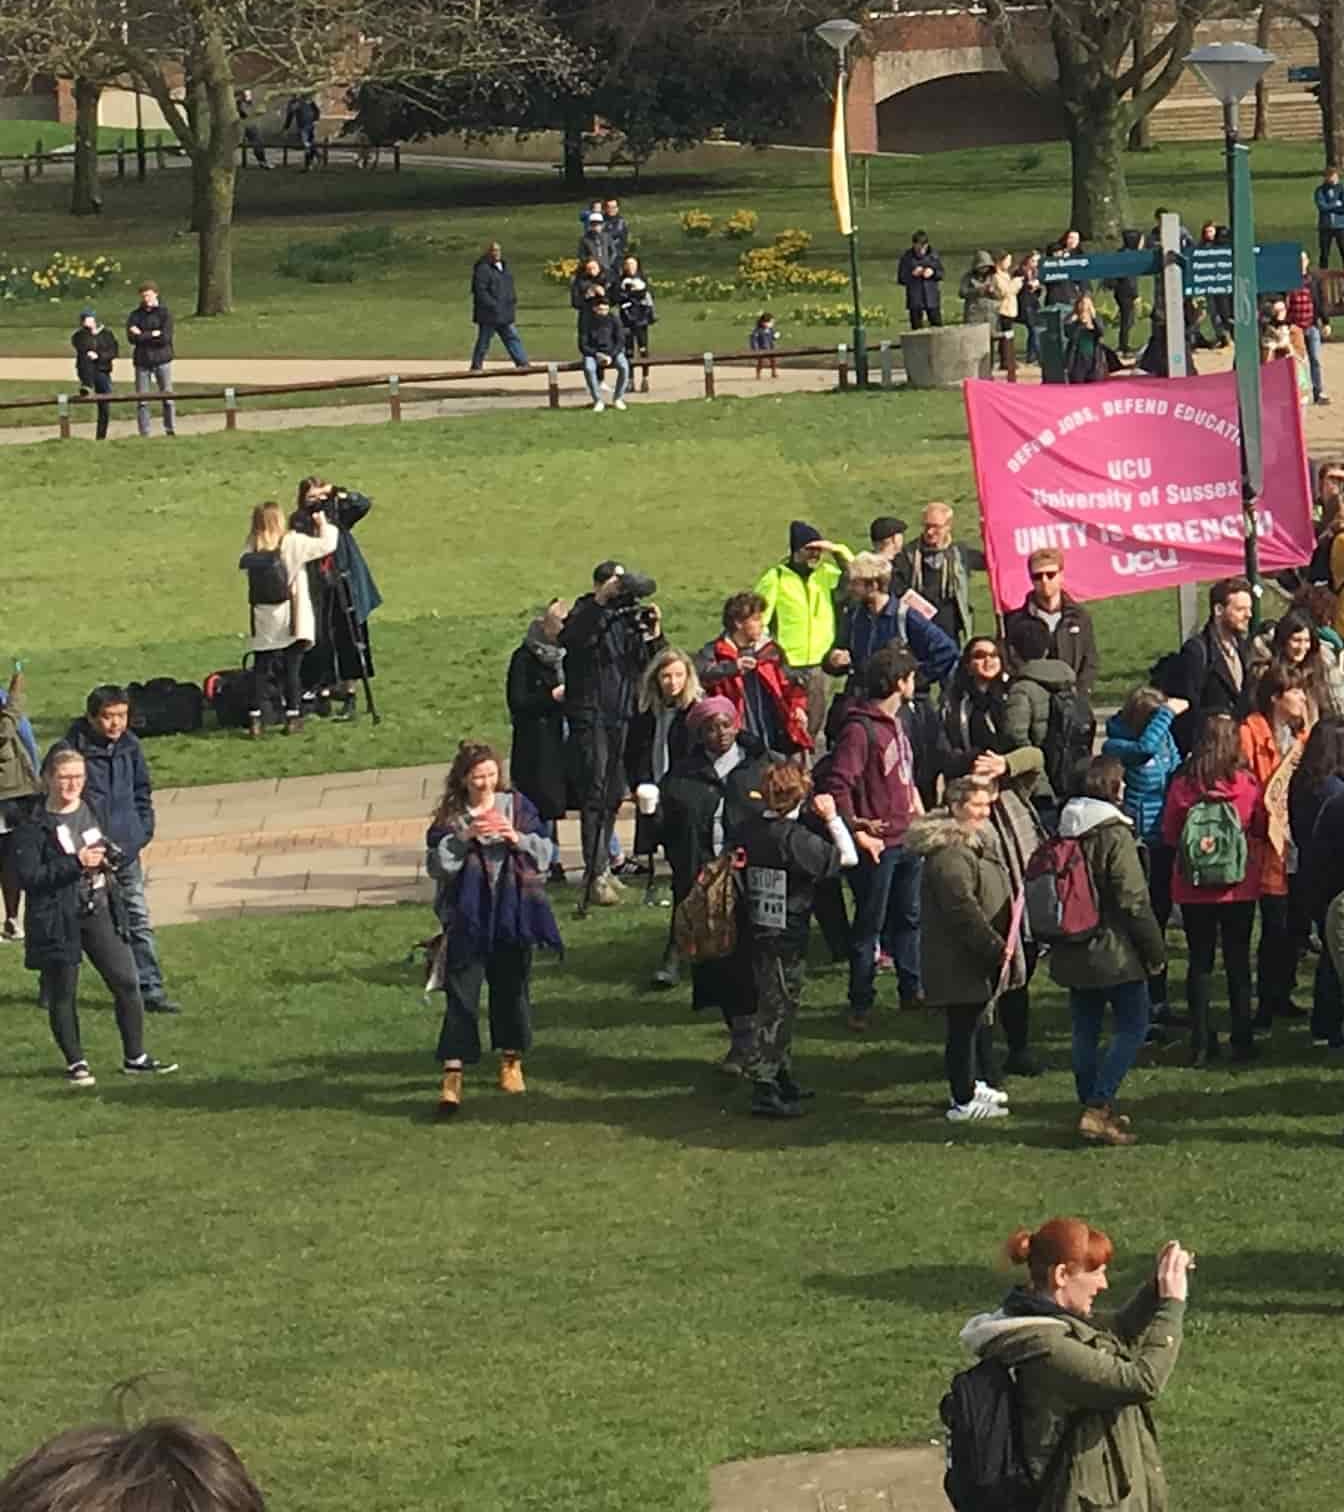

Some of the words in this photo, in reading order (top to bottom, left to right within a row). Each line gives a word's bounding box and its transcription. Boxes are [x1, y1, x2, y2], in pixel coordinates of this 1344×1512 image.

[1101, 397, 1169, 417] DEFEND
[1173, 402, 1242, 447] EDUCATI
[1107, 457, 1152, 481] UCU
[1033, 487, 1132, 512] University
[1139, 485, 1160, 506] of
[1165, 479, 1239, 505] Sussex
[1014, 522, 1089, 555] UNITY
